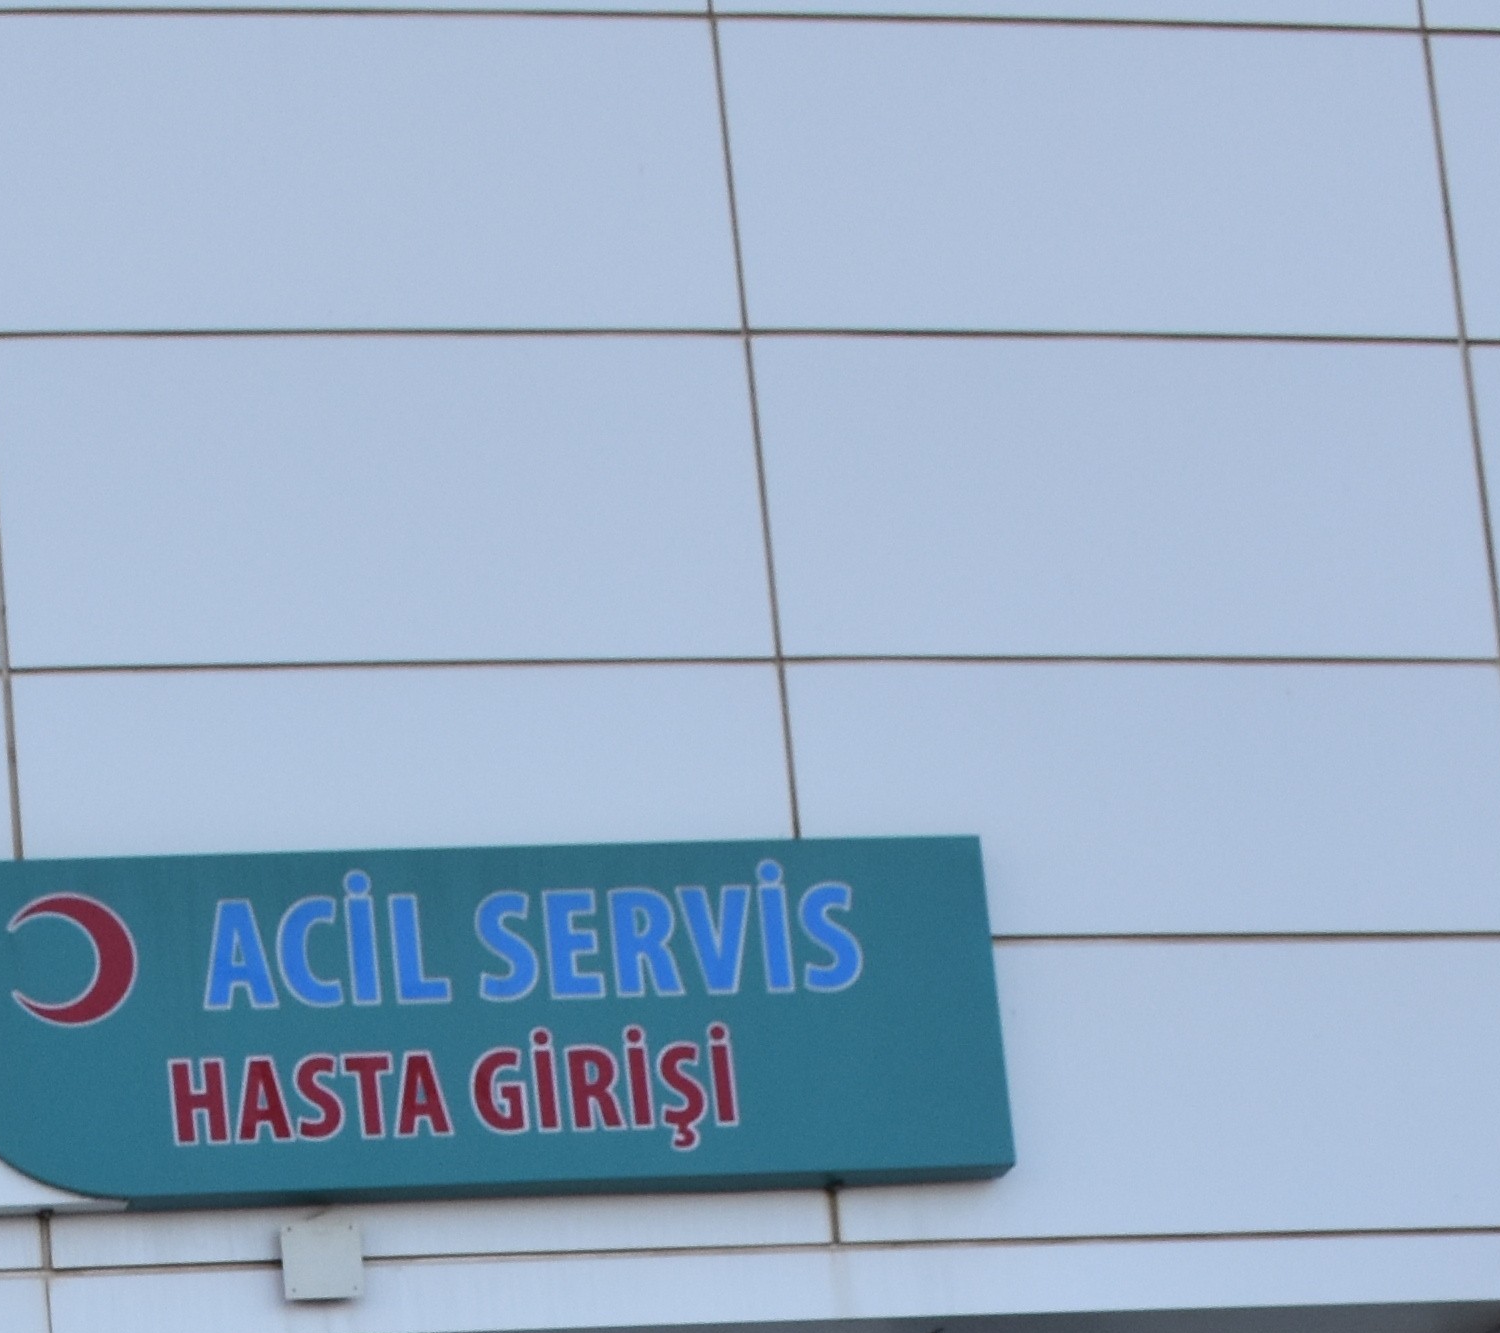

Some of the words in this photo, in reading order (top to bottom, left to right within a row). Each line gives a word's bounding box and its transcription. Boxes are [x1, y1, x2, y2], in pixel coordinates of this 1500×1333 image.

[203, 868, 452, 1010] ACİL
[474, 858, 863, 1002] SERVİS
[167, 1050, 454, 1146] HASTA
[470, 1020, 740, 1152] GİRİŞİ
